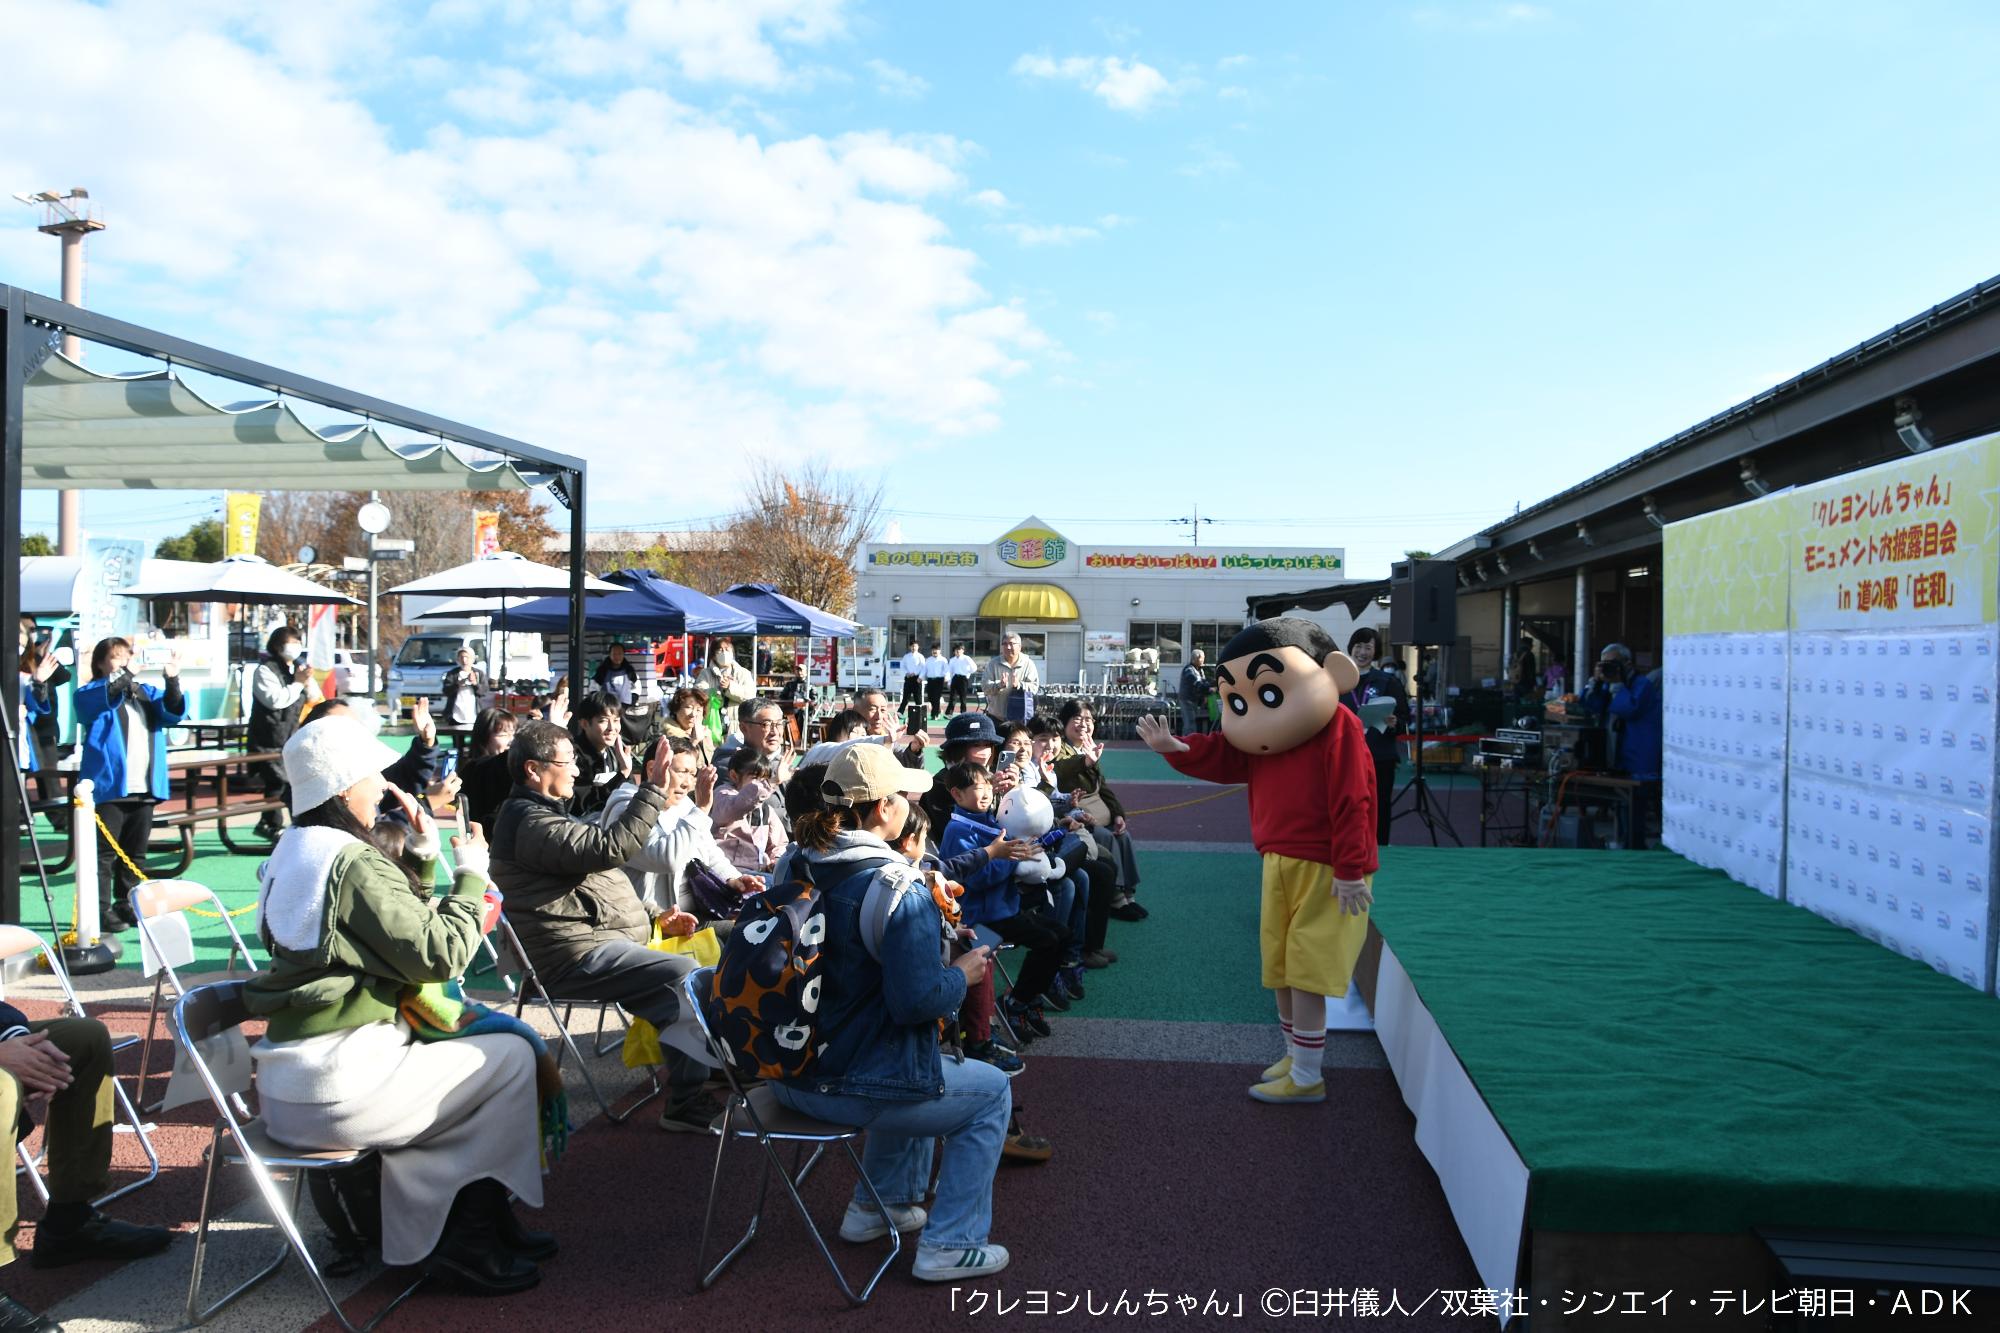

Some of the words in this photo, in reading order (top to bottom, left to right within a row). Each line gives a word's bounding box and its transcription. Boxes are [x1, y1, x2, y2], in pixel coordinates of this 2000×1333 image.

[1812, 474, 1952, 528] 「クレヨンしんちゃん」
[998, 537, 1066, 561] 食彩館
[1805, 519, 1957, 572] モニュメントお披露目会
[874, 550, 977, 567] 食の専門店街
[1224, 553, 1337, 570] いらっしゃいませ
[1837, 583, 1852, 610] in
